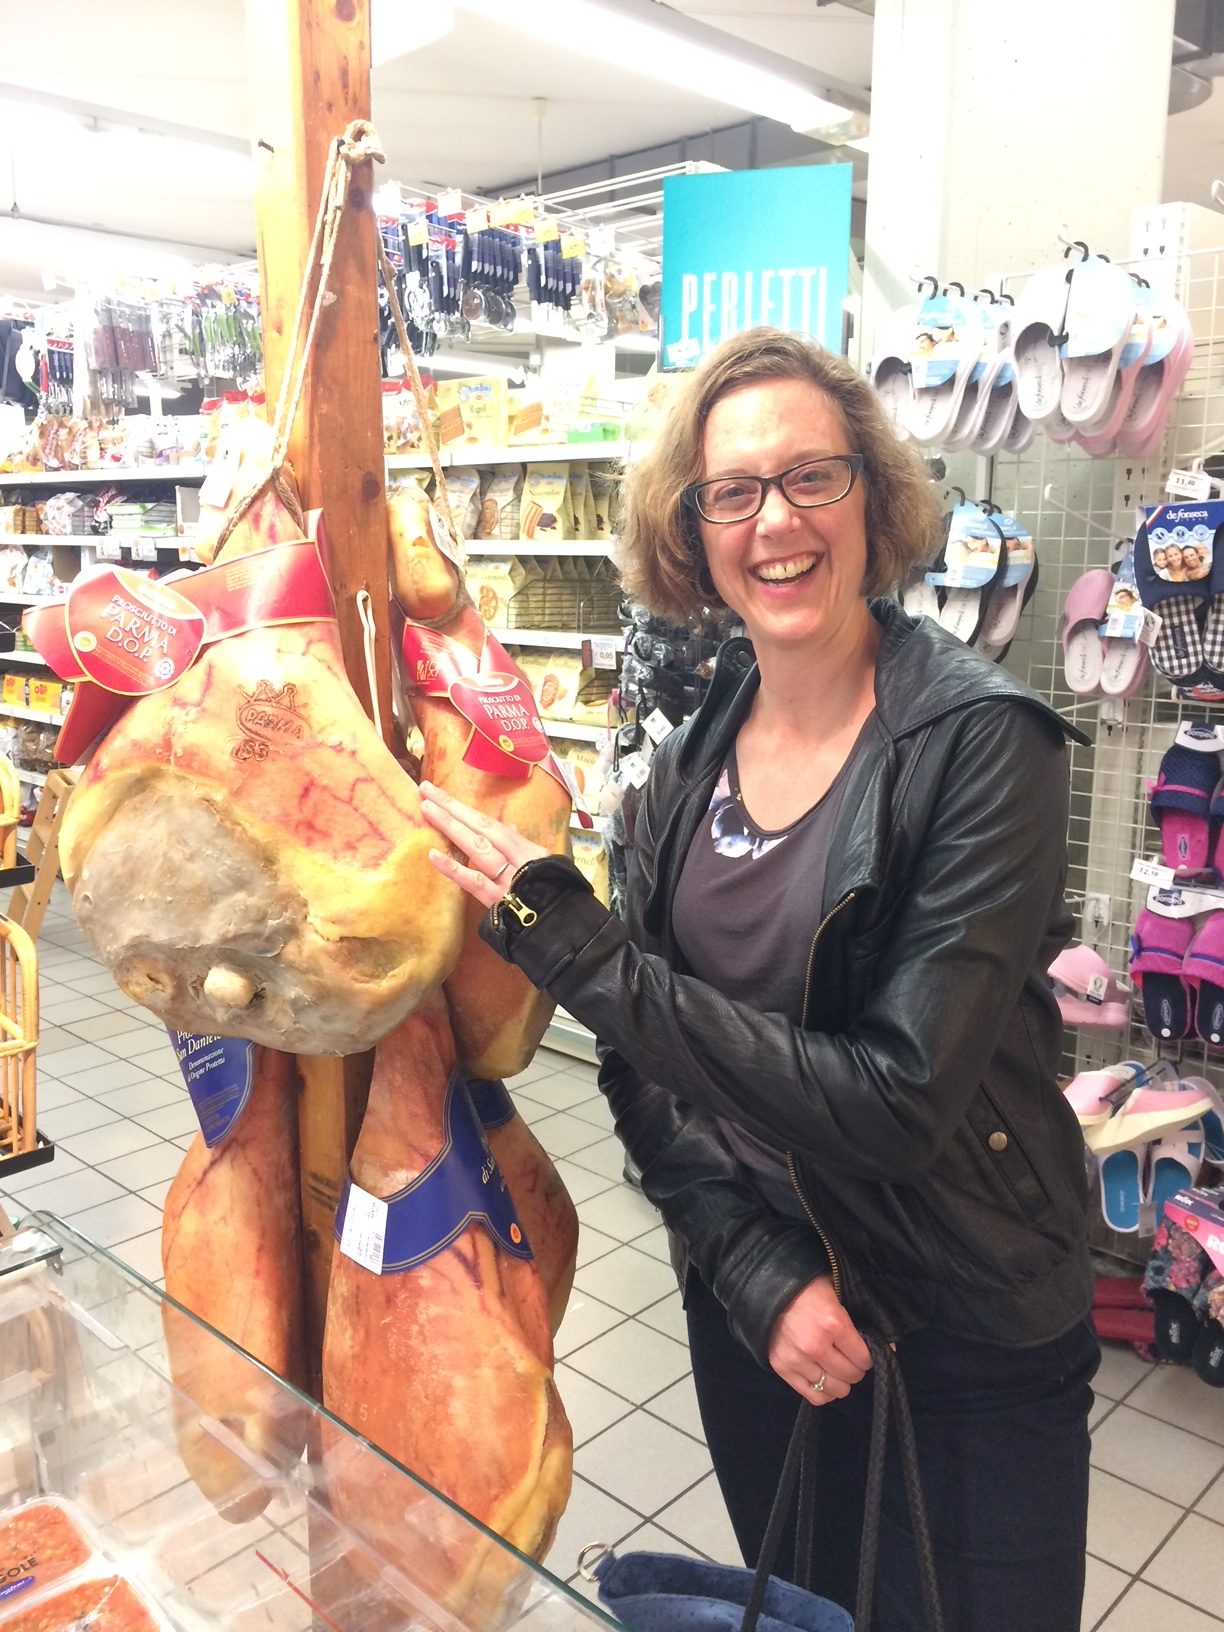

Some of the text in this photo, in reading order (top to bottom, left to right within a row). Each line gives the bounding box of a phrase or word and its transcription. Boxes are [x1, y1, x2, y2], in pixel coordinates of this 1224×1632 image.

[100, 603, 169, 656] PARMA
[111, 593, 169, 632] PROSCIUTTO
[105, 626, 152, 663] D.O.P.
[483, 703, 530, 720] PARMA
[500, 717, 530, 732] D.O.P.
